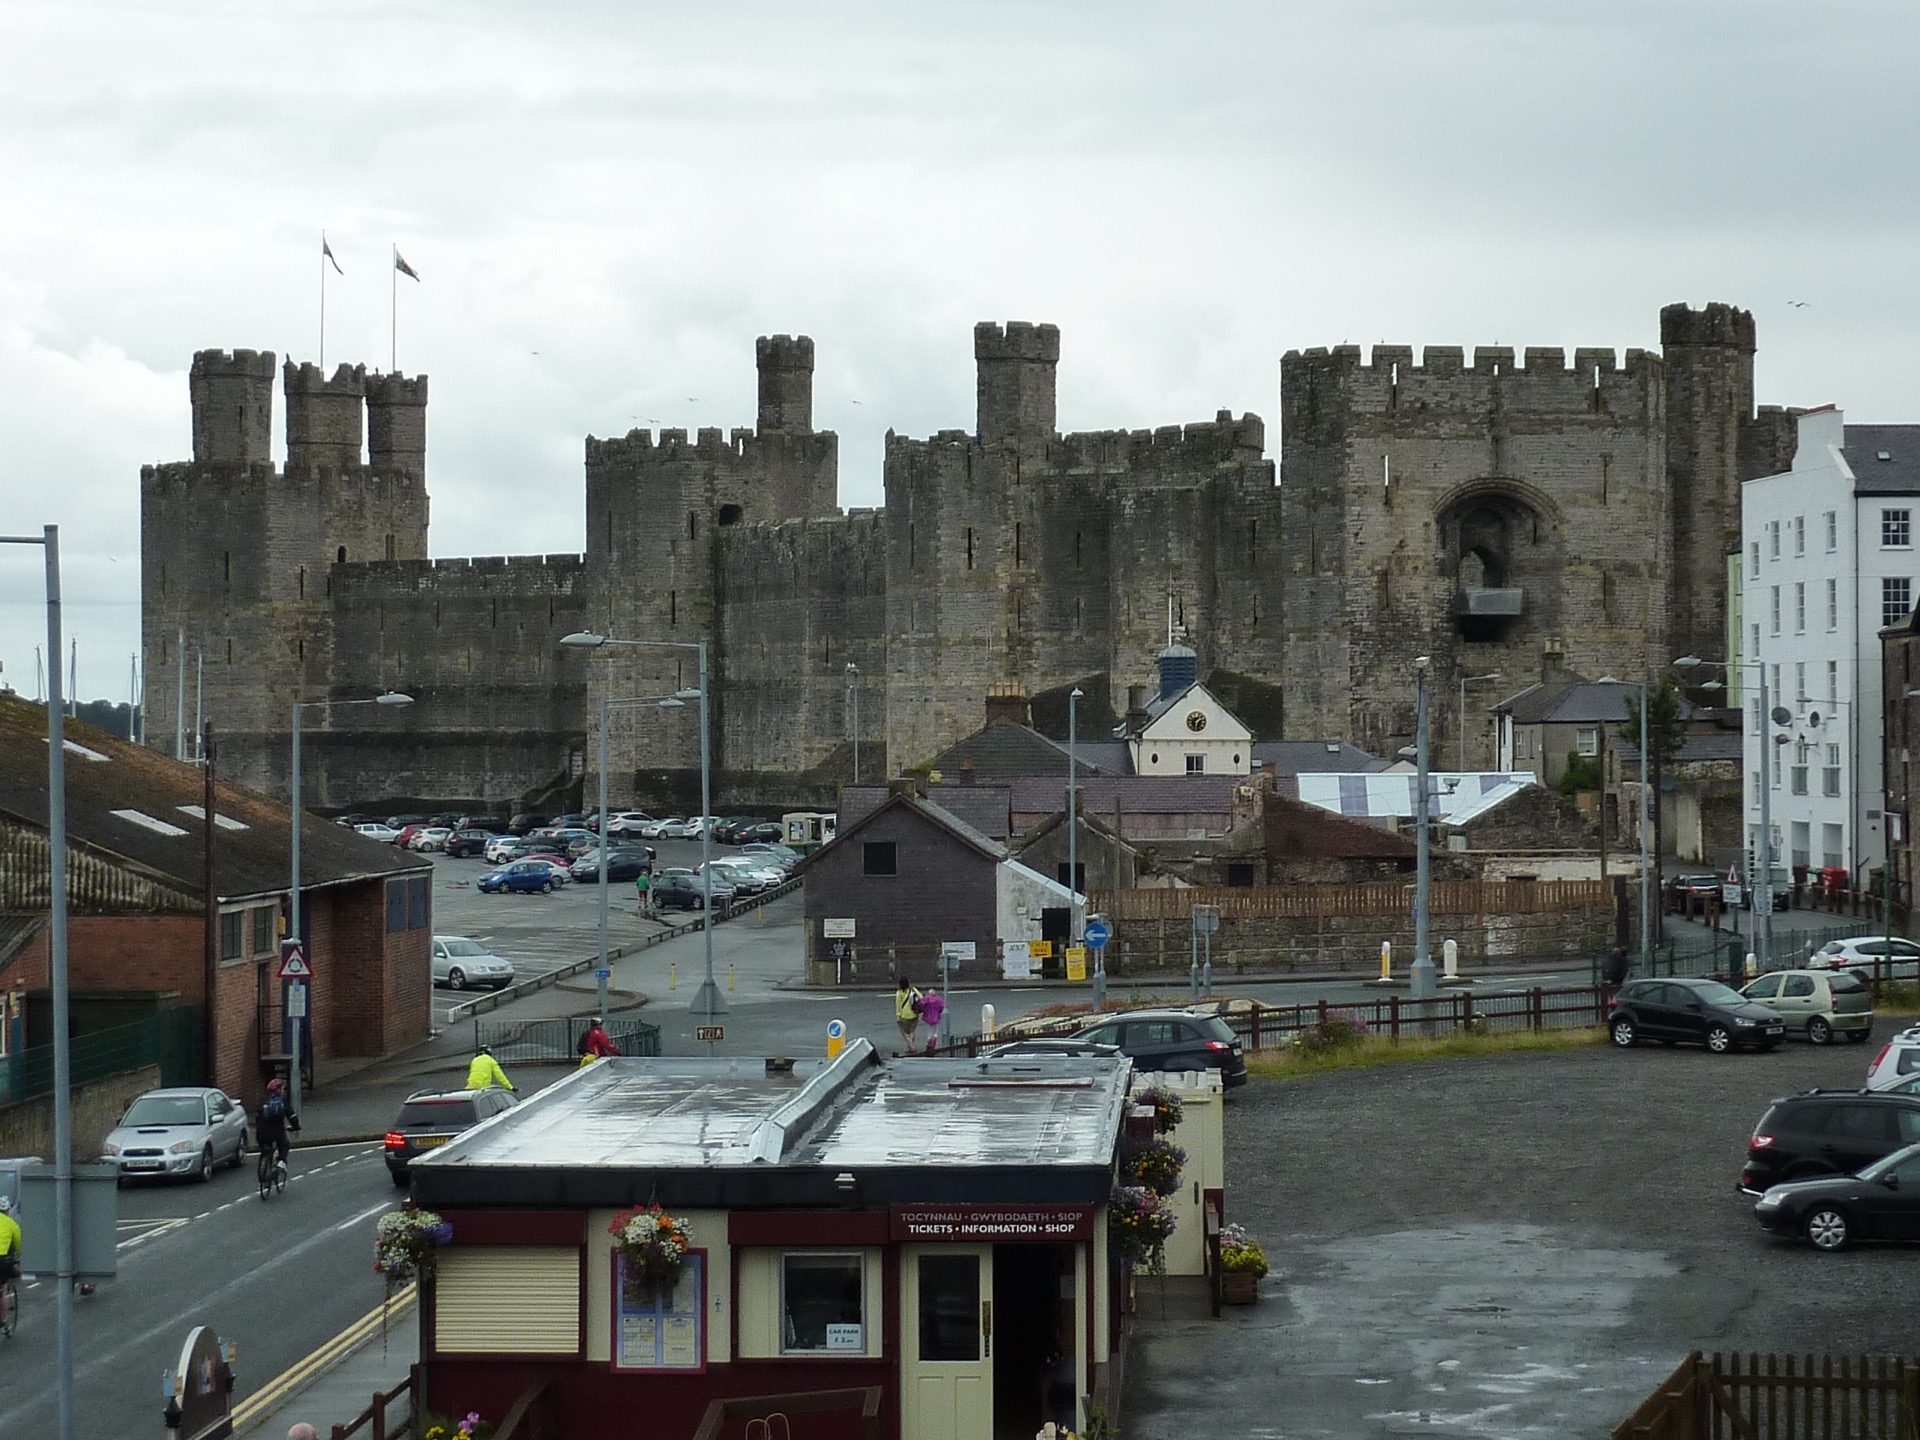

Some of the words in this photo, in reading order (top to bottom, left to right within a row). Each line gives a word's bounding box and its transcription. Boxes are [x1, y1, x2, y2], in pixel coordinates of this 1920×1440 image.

[901, 1213, 962, 1221] TOCYNNAU
[971, 1213, 1049, 1221] GWYBODAETH
[1058, 1212, 1083, 1221] SIOP
[908, 1225, 953, 1233] TICKETS
[961, 1224, 1037, 1233] INFORMATION
[1045, 1224, 1075, 1233] SHOP
